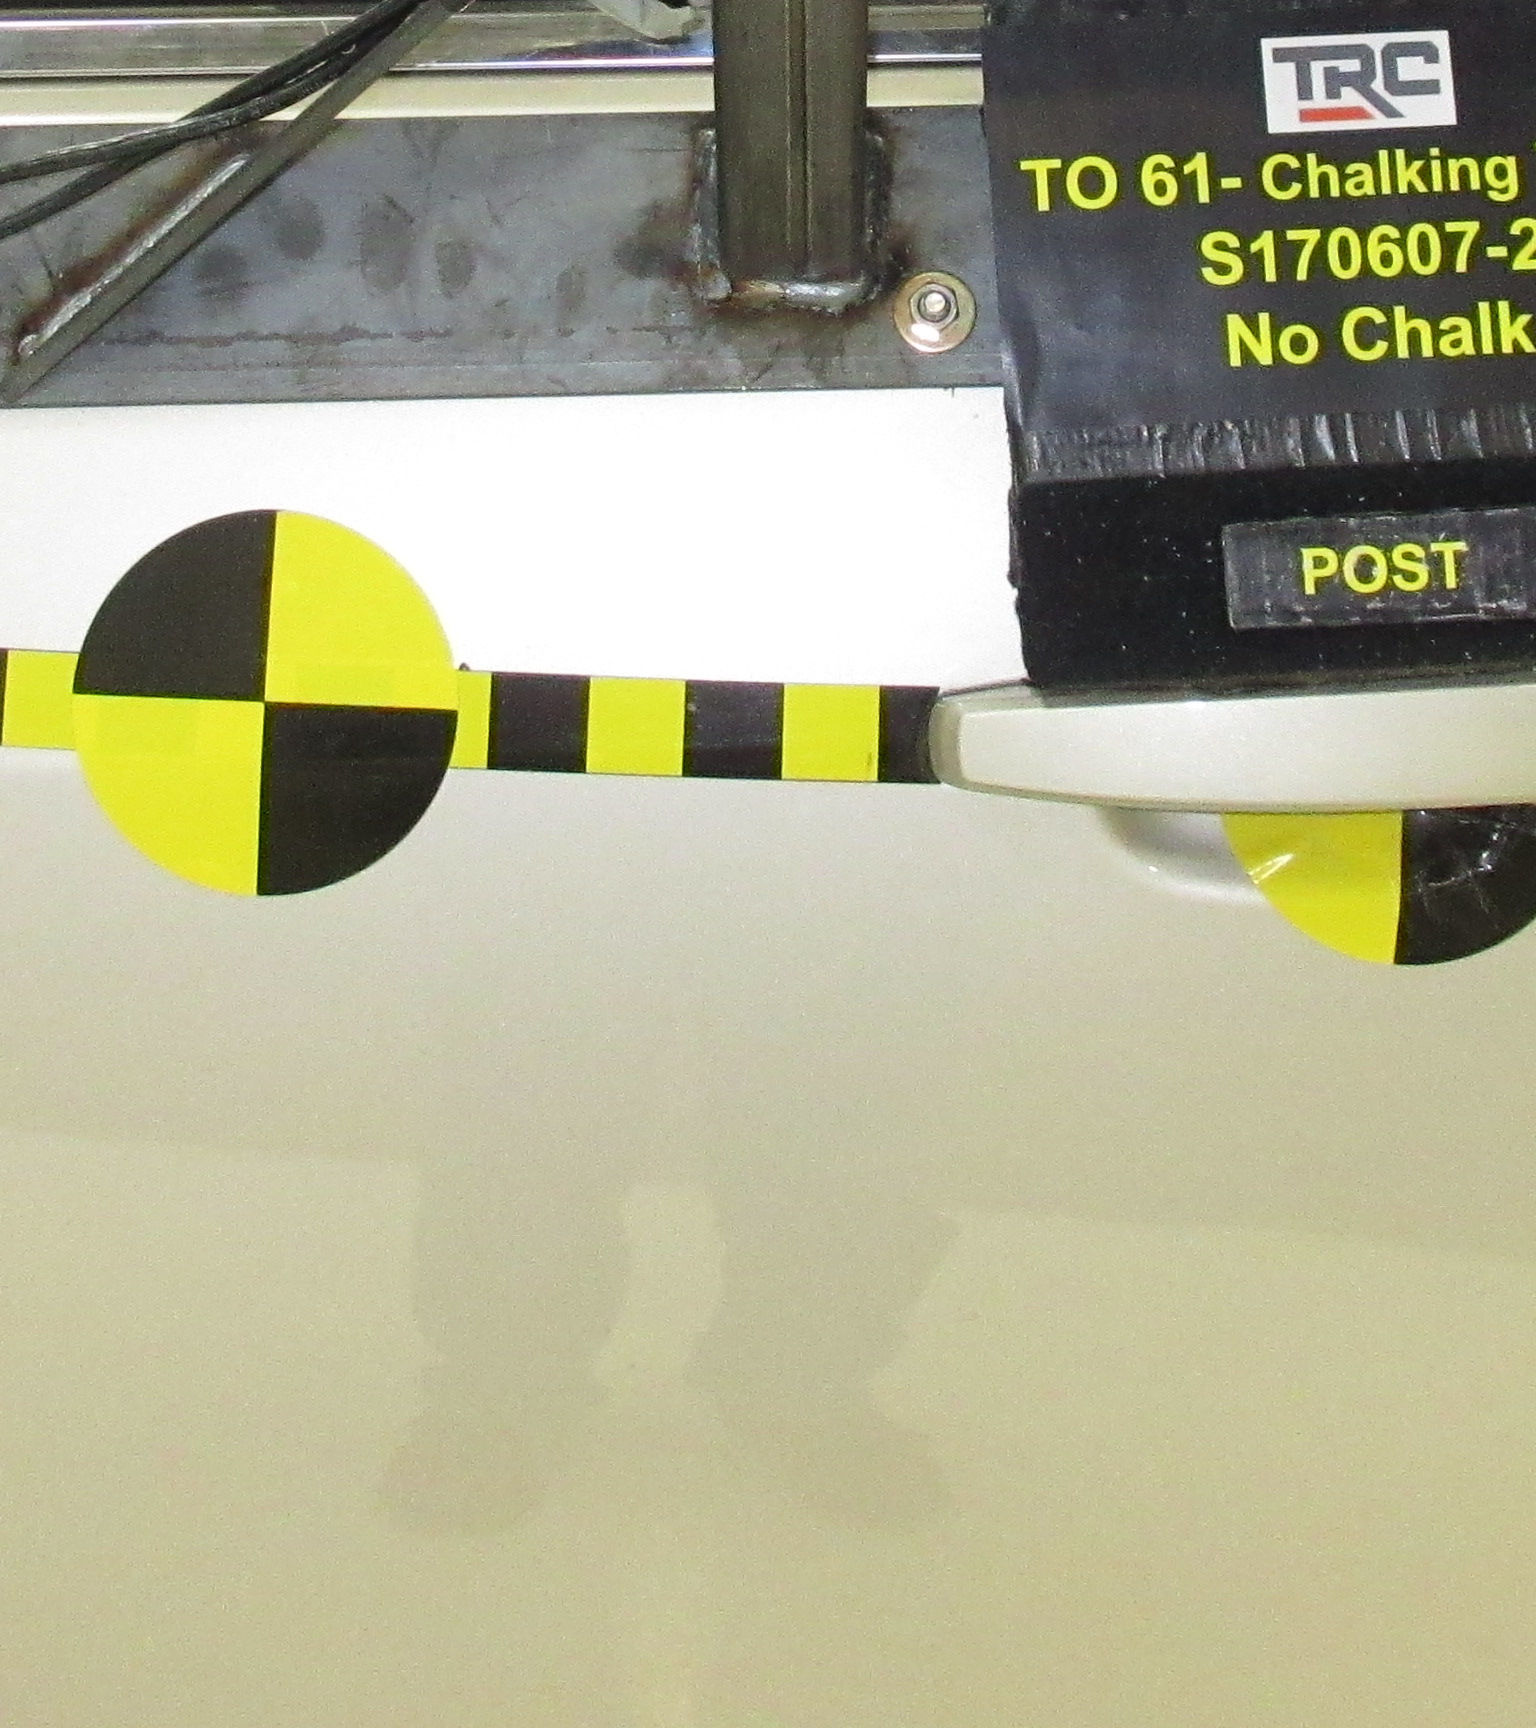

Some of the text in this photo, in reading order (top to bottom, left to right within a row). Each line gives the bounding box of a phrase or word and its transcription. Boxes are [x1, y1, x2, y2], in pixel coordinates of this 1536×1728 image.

[1272, 41, 1441, 119] TRC
[1020, 155, 1120, 214] TO
[1140, 152, 1243, 207] 61-
[1261, 147, 1520, 204] Chalking
[1226, 310, 1319, 368] No
[1300, 540, 1470, 596] POST
